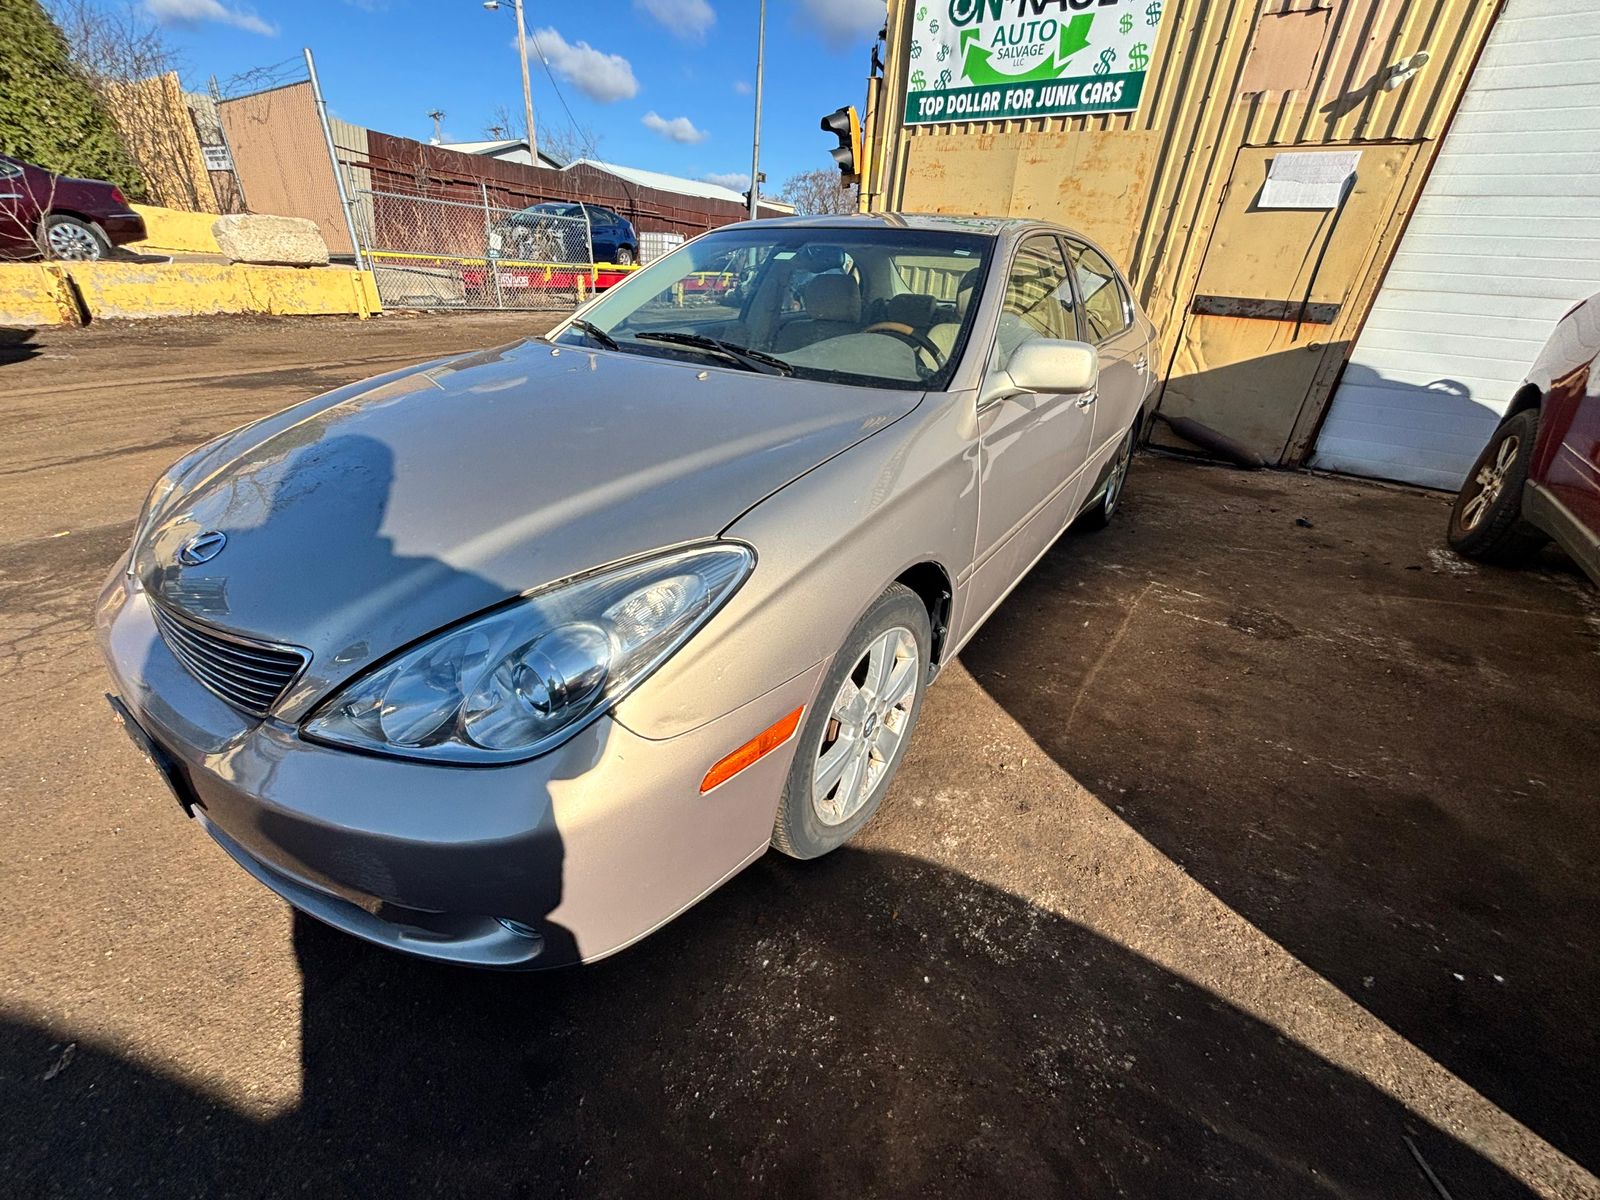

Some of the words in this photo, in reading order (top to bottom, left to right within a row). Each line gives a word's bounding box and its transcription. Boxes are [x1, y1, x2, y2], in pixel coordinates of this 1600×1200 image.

[991, 19, 1057, 47] AUTO
[997, 43, 1045, 60] SALVAGE
[1013, 58, 1025, 67] LLC
[919, 96, 944, 115] TOP
[947, 91, 1000, 114] DOLLAR
[1004, 88, 1034, 110] FOR
[1036, 84, 1079, 107] JUNK
[1080, 80, 1125, 104] CARS
